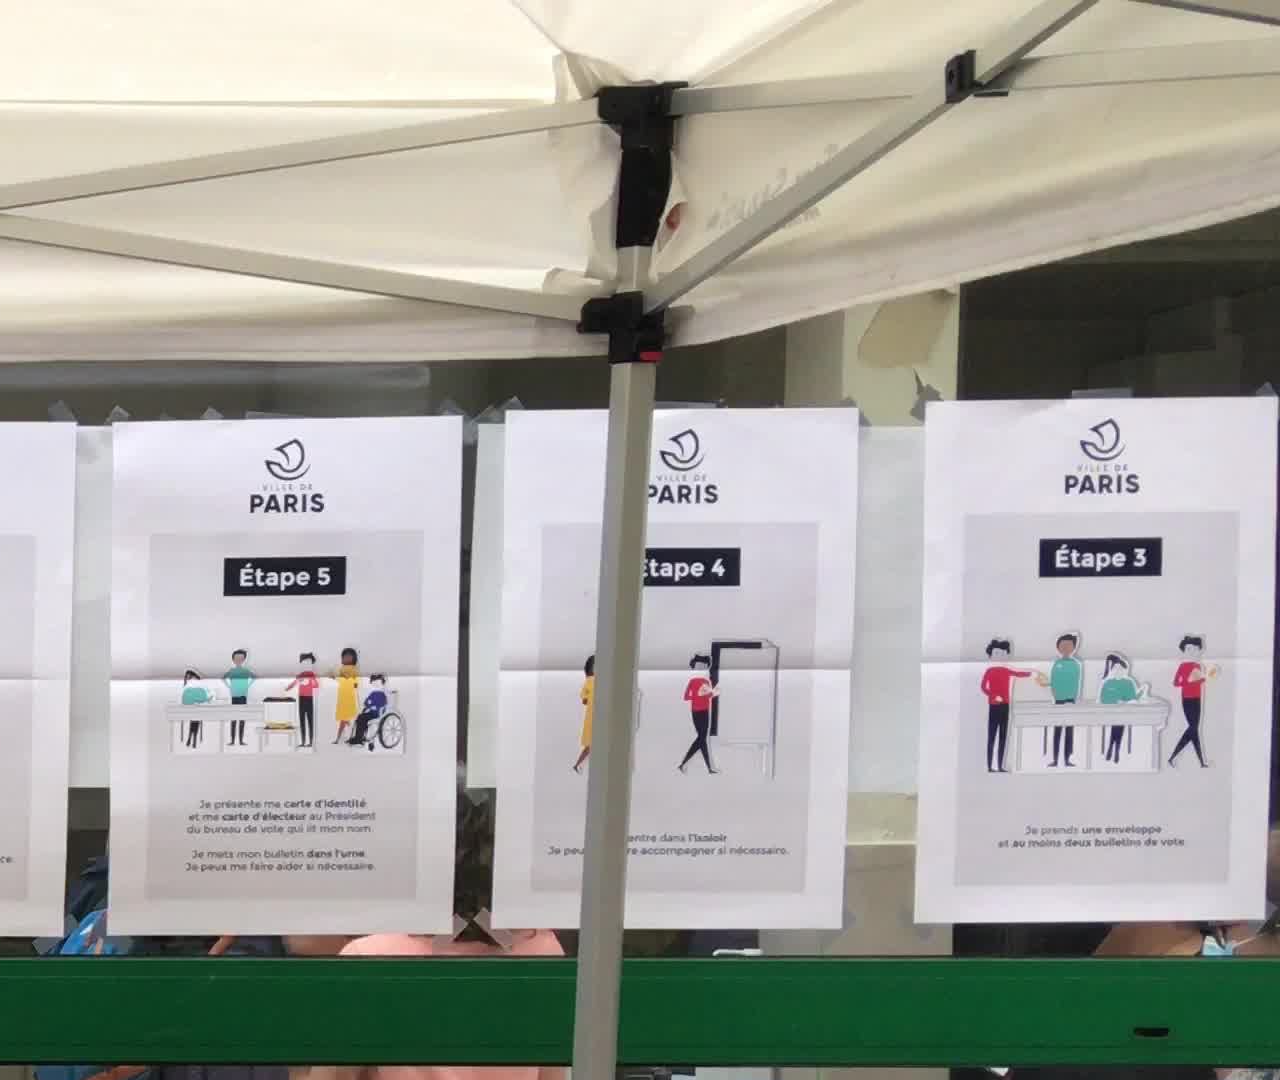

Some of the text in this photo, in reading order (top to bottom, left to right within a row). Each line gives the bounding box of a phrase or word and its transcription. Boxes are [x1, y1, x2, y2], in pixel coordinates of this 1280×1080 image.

[1077, 463, 1128, 472] VILLE DE
[656, 474, 707, 482] VILLE DE
[262, 483, 313, 492] VILLE DE
[1064, 474, 1140, 494] PARIS
[249, 493, 325, 513] PARIS
[1055, 544, 1147, 572] Étape 3
[711, 558, 726, 577] 4
[240, 562, 331, 591] Étape 5
[200, 799, 211, 809] Je
[214, 800, 261, 811] présente
[284, 800, 311, 809] carte
[189, 812, 200, 821] et
[222, 812, 250, 821] carte
[252, 811, 306, 821] d'électeur
[186, 824, 201, 833] du
[203, 824, 241, 833] bureau
[244, 824, 257, 833] de
[261, 825, 284, 833] vote
[1081, 827, 1102, 835] une
[627, 834, 657, 842] entre
[1012, 839, 1026, 848] au
[1064, 838, 1091, 848] deux
[1144, 838, 1158, 847] de
[192, 849, 205, 859] Je
[237, 851, 261, 859] mon
[306, 849, 332, 858] dans
[563, 848, 585, 857] peu
[641, 848, 716, 858] accompagner
[200, 864, 227, 873] peux
